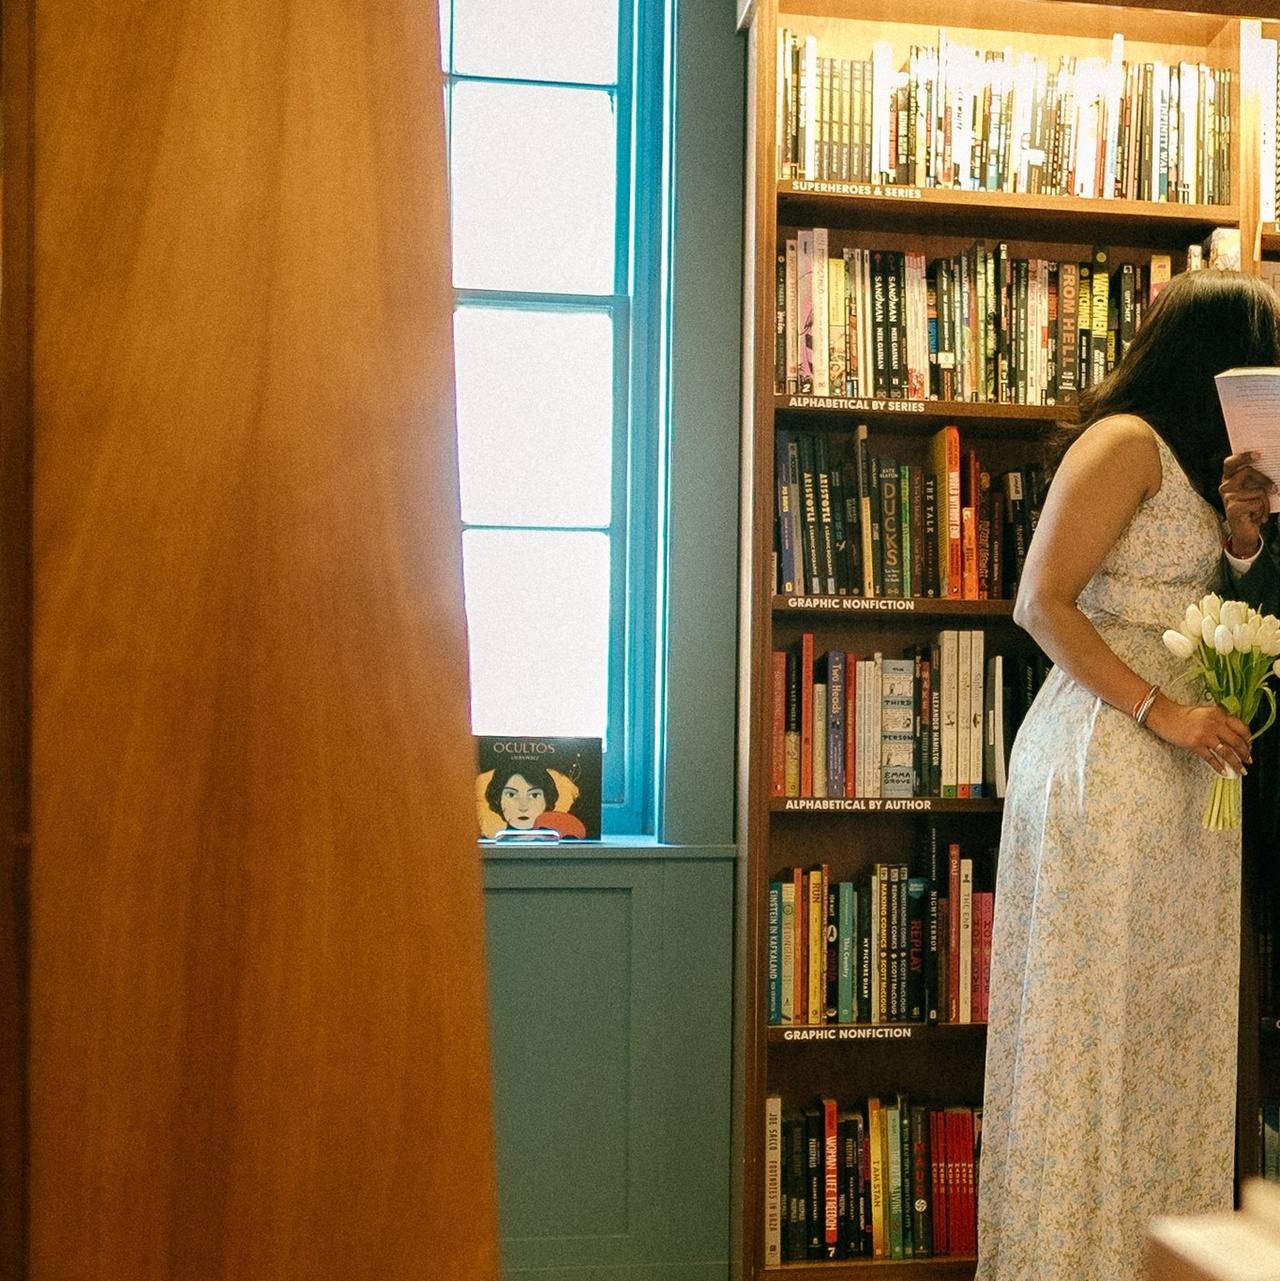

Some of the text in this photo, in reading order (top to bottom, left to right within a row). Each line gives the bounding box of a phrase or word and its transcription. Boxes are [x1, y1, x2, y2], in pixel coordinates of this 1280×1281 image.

[1159, 104, 1168, 174] INFINITY WAR
[793, 181, 922, 199] SUPERHEROES & SERIES
[1063, 264, 1077, 367] FROM HELL
[1078, 279, 1090, 329] WATCHMEN
[1092, 273, 1109, 337] WATCHMEN
[874, 276, 885, 369] SANDMAN NEIL GAIMAN
[888, 276, 899, 369] SANDMAN NEIL GAIMAN
[789, 397, 925, 412] ALPHABETICAL BY SERIES
[803, 472, 815, 522] ARISTOTLE
[819, 473, 831, 523] ARISTOTLE
[926, 480, 934, 534] THE TALK
[949, 472, 961, 539] WORLD WITHOUT END
[883, 482, 898, 566] DUCKS
[1016, 525, 1024, 555] MURDER
[788, 598, 915, 611] GRAPHIC NONFICTION
[831, 663, 842, 713] Two Heads
[932, 691, 940, 766] ALEXANDER HAMILTON
[493, 742, 555, 754] OCULTOS
[785, 800, 932, 810] ALPHABETICAL BY AUTHOR
[769, 890, 778, 924] EINSTEIN
[812, 882, 821, 904] RUN
[962, 893, 970, 910] THE
[930, 891, 938, 952] NIGHT TERROR
[769, 935, 778, 980] KAFKALAND
[862, 938, 869, 947] MY
[909, 919, 922, 972] REPLAY
[842, 951, 851, 978] Country
[784, 1028, 912, 1041] GRAPHIC NONFICTION
[769, 1113, 778, 1125] JOE
[769, 1129, 778, 1150] SACCO
[808, 1138, 817, 1168] PERSEPOLIS
[769, 1161, 778, 1199] FOOTNOTES
[826, 1135, 837, 1231] WOMAN LIFE FREEDOM
[873, 1166, 880, 1182] AM
[914, 1143, 927, 1197] MAUS
[873, 1184, 881, 1208] STAN
[769, 1213, 778, 1232] GAZA
[827, 1247, 836, 1258] 7
